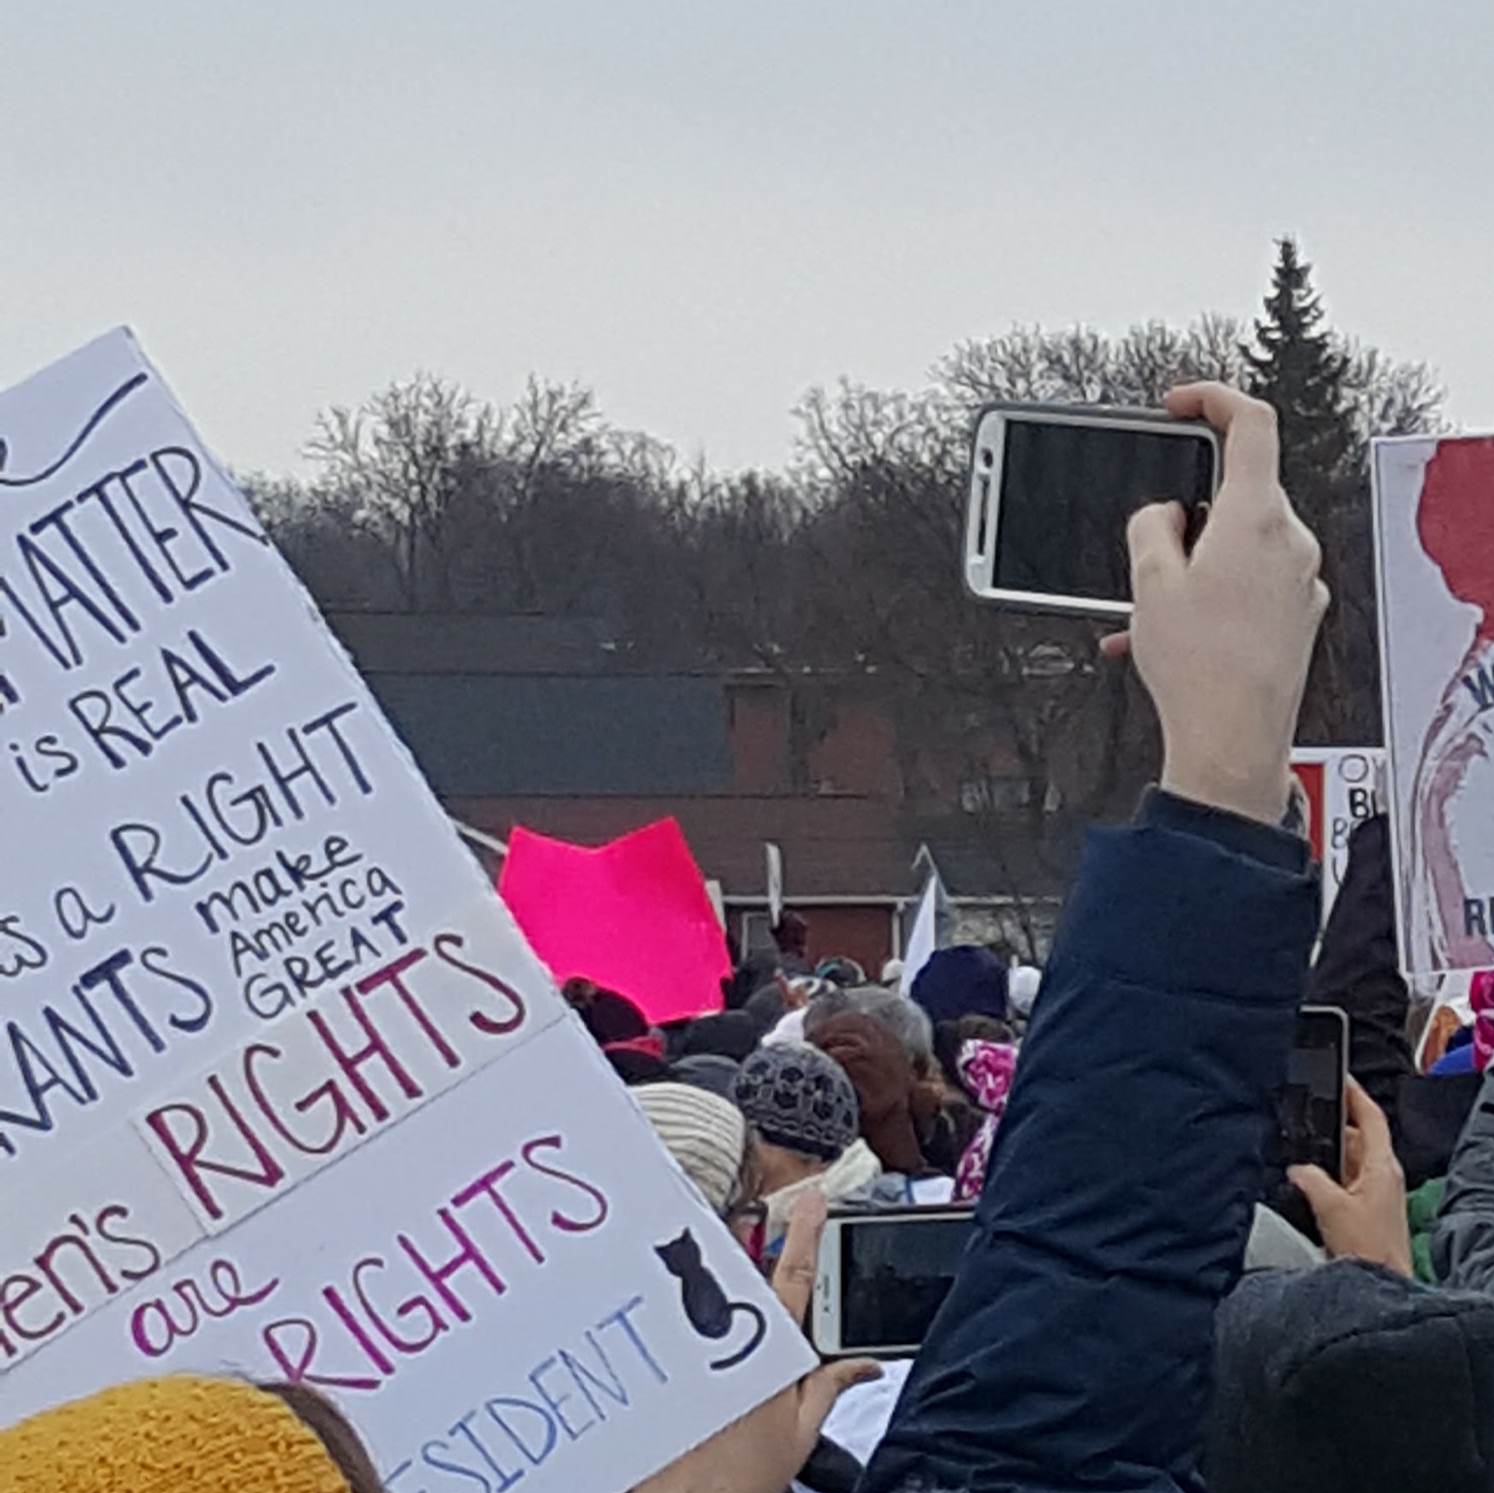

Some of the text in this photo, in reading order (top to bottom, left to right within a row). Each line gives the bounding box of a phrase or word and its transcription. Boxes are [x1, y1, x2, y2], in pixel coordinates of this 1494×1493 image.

[10, 629, 275, 792] is REAL
[55, 887, 116, 940] a
[111, 702, 373, 901] RIGHT
[195, 836, 363, 934] make
[230, 866, 403, 977] America
[244, 900, 409, 1020] GREAT
[0, 933, 526, 1357] en's RIGHTS
[130, 1258, 280, 1358] are
[263, 1134, 609, 1391] RIGHTS
